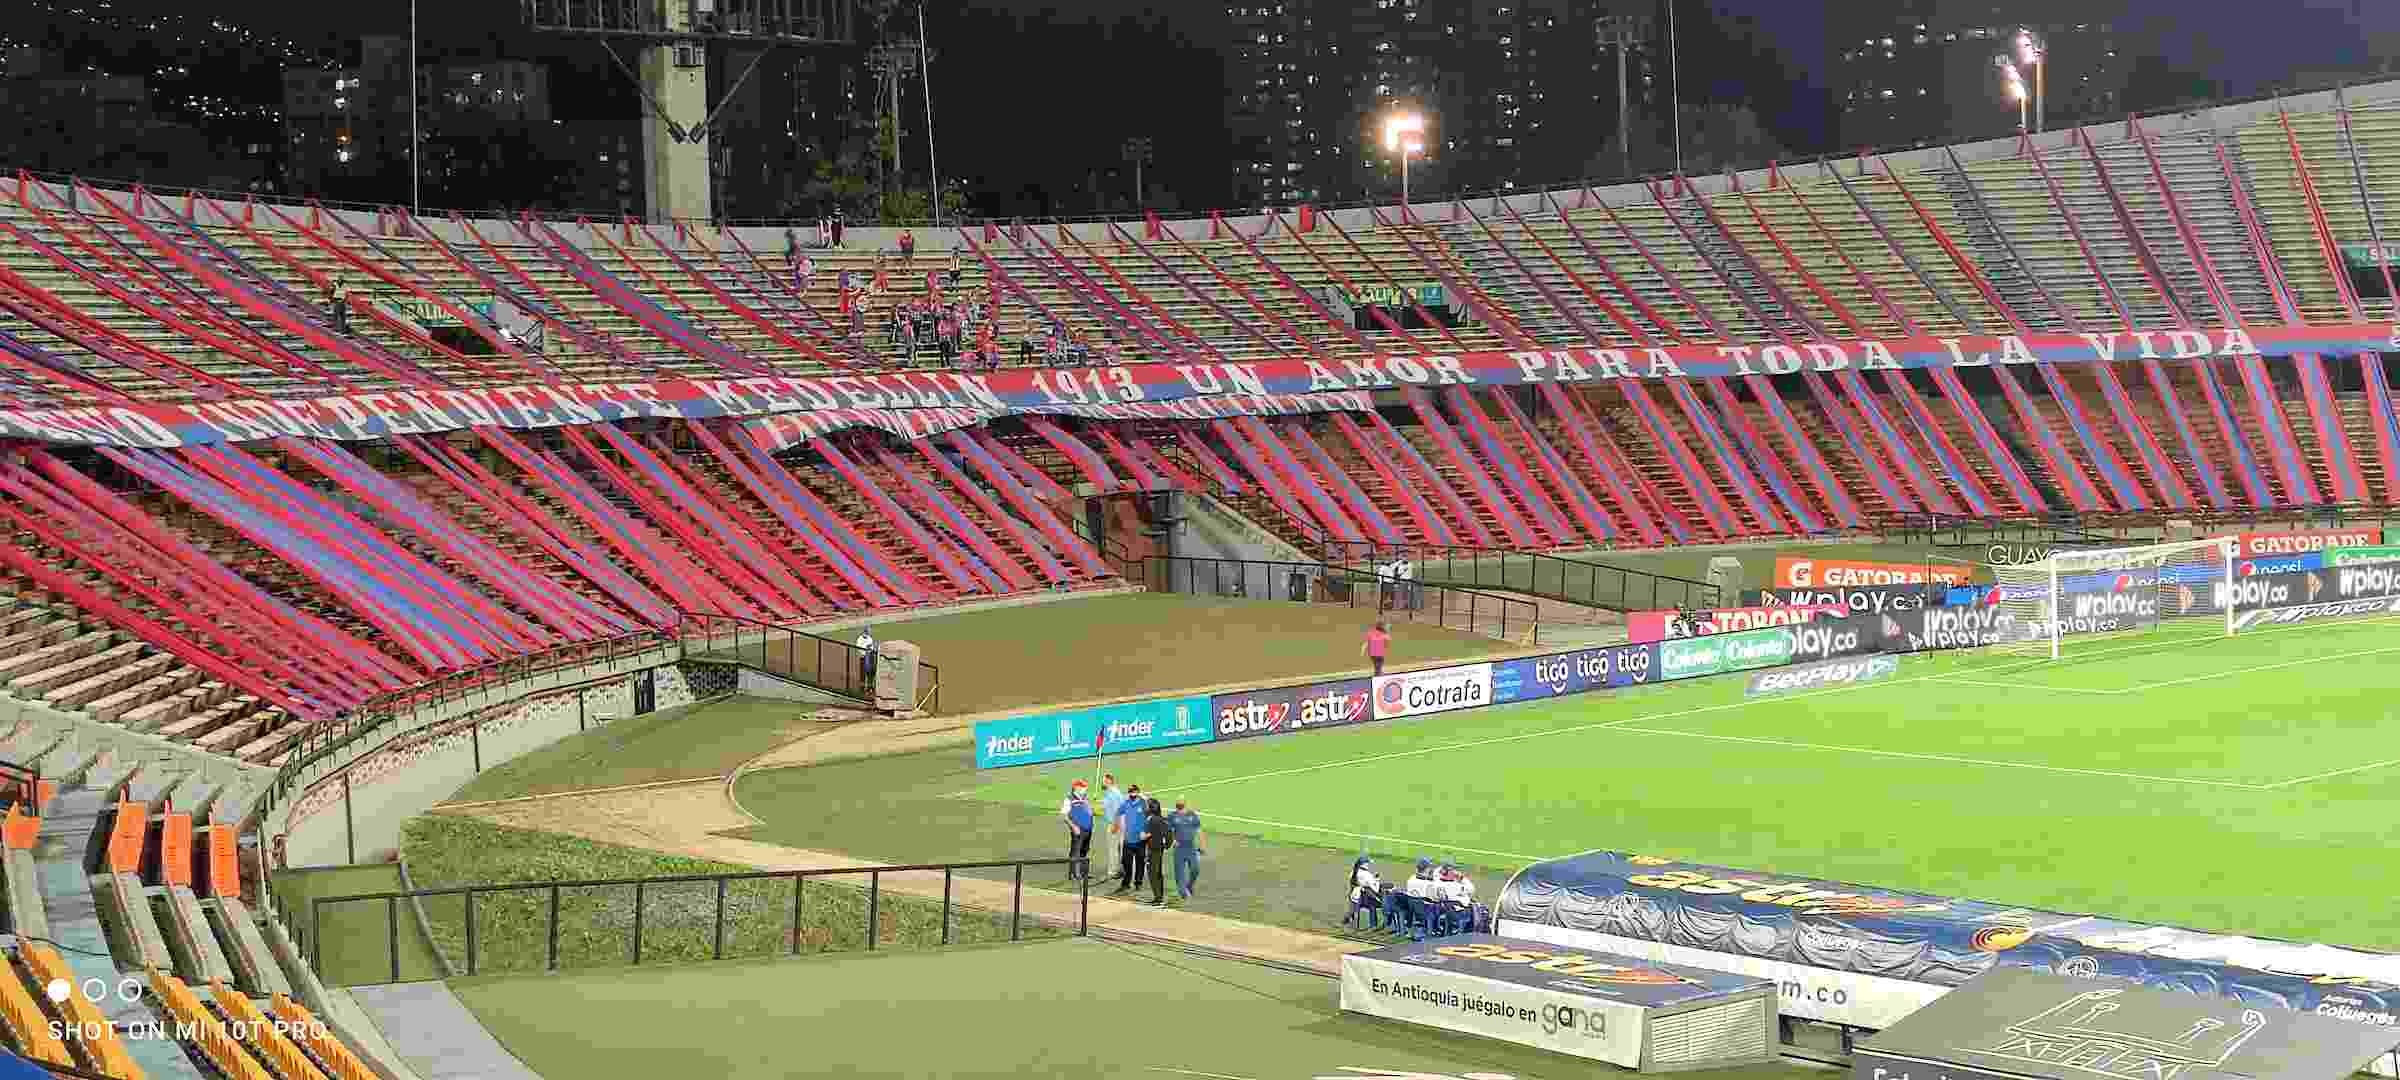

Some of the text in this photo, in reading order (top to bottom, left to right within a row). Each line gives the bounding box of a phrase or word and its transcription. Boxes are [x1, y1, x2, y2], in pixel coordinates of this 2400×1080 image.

[1032, 366, 1144, 403] 1913
[1175, 362, 1265, 396] UN
[1304, 355, 1476, 391] AMOR
[1508, 348, 1687, 382] PARA
[1717, 341, 1904, 375] TODA
[1939, 336, 2037, 367] LA
[2079, 328, 2258, 360] VIDA
[2250, 534, 2369, 552] GATORADE
[1408, 679, 1481, 708] Cotrafa
[1371, 978, 1389, 995] En
[1463, 993, 1516, 1018] juégalo
[1519, 1008, 1537, 1023] en
[1542, 1002, 1606, 1035] gana
